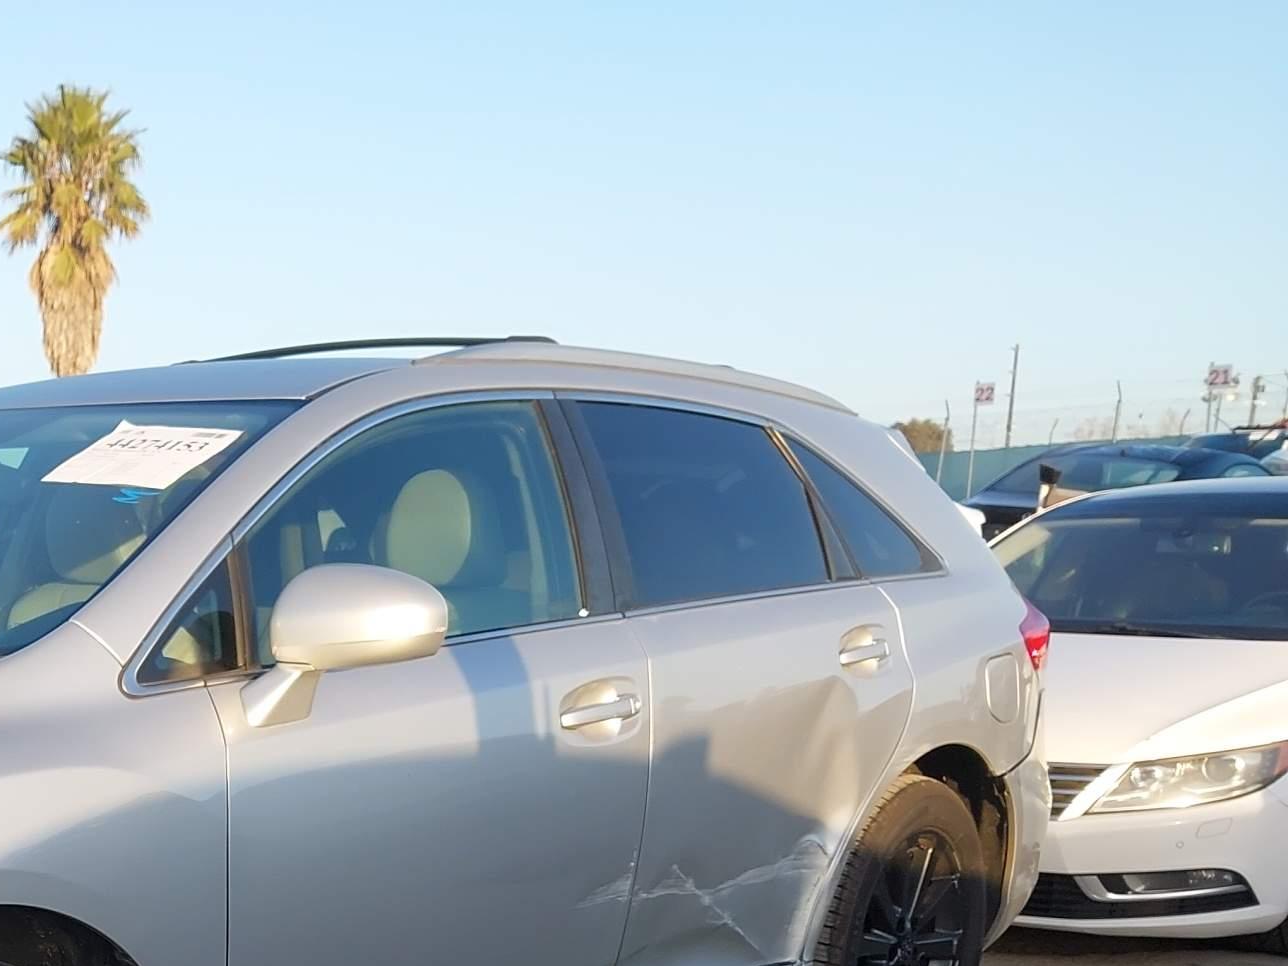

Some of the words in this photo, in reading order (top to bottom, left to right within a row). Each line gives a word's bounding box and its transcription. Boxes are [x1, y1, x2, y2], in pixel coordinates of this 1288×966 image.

[1209, 369, 1230, 385] 21
[975, 386, 994, 402] 22
[107, 439, 209, 453] 44274153
